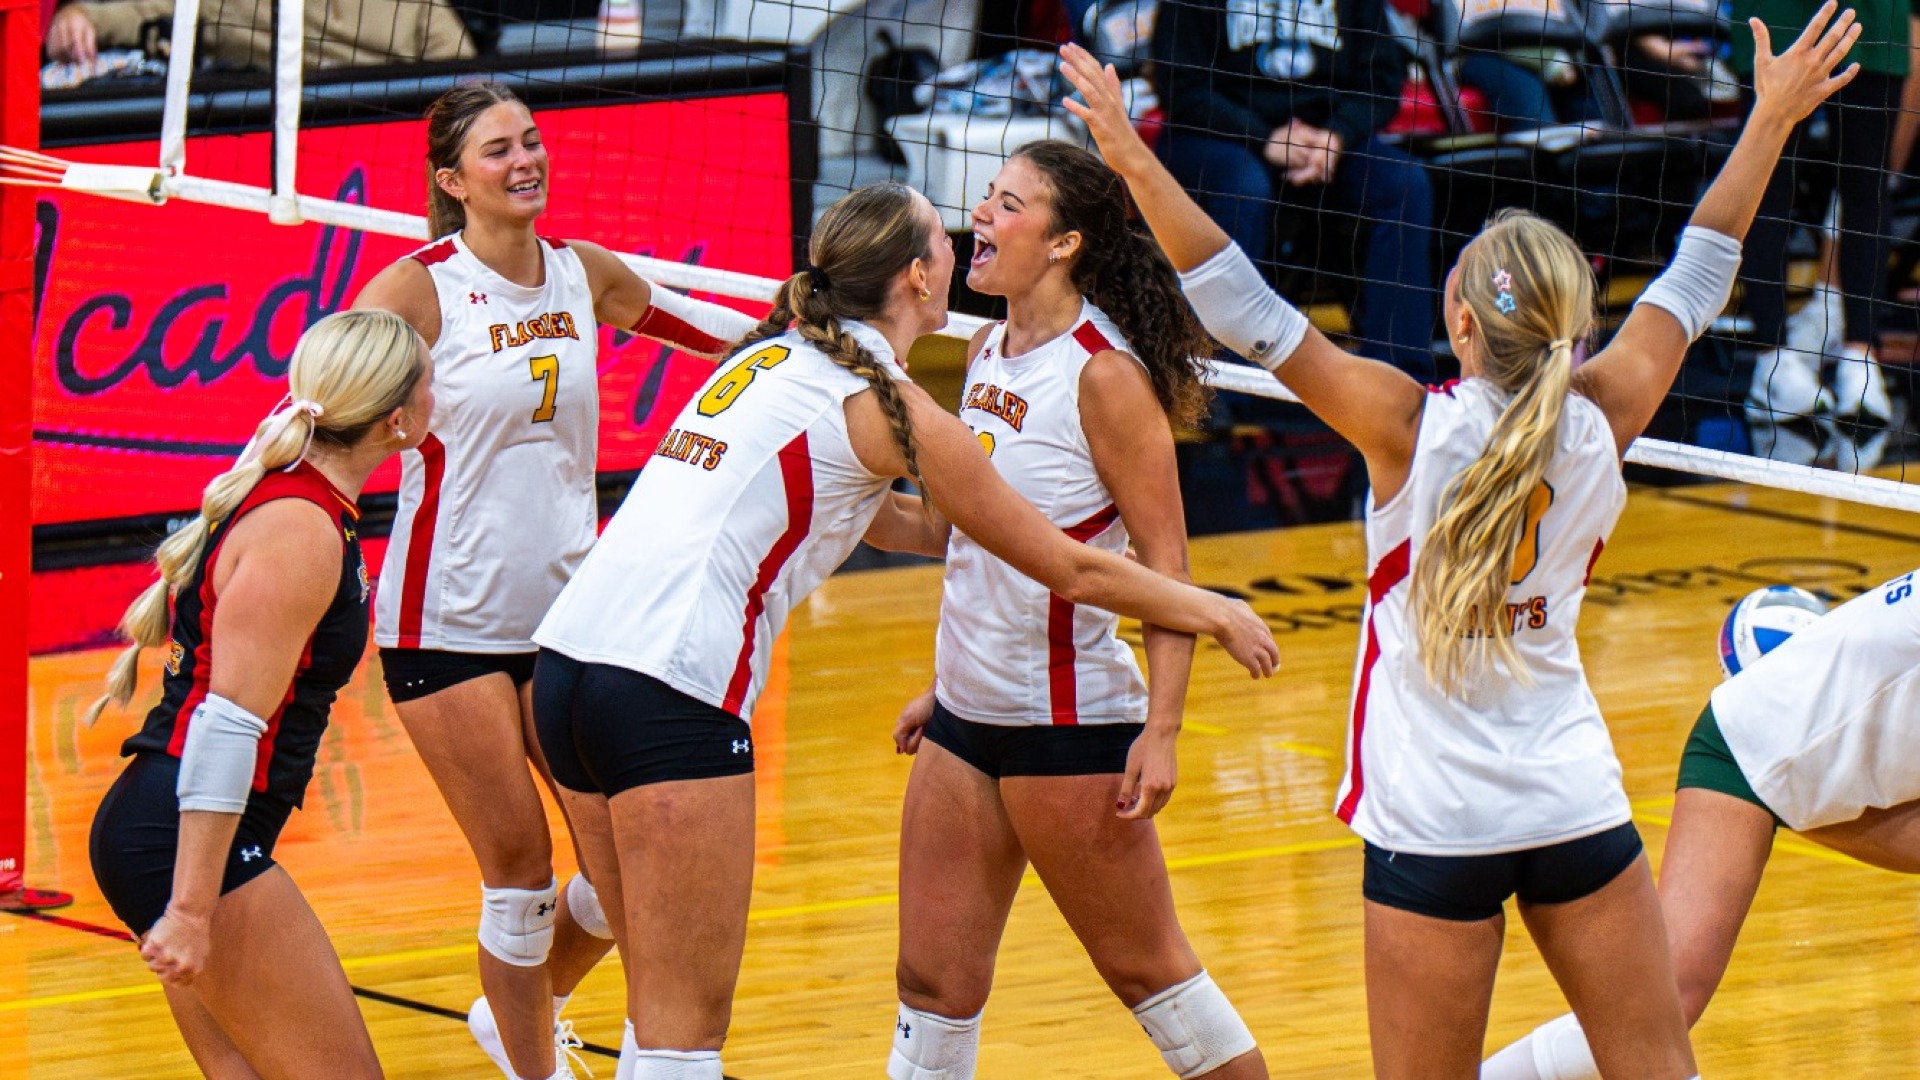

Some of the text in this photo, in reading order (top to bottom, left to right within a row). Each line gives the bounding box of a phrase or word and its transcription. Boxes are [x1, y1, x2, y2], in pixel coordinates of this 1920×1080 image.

[529, 353, 560, 424] 7
[696, 343, 792, 419] 6
[654, 428, 728, 472] AINTS
